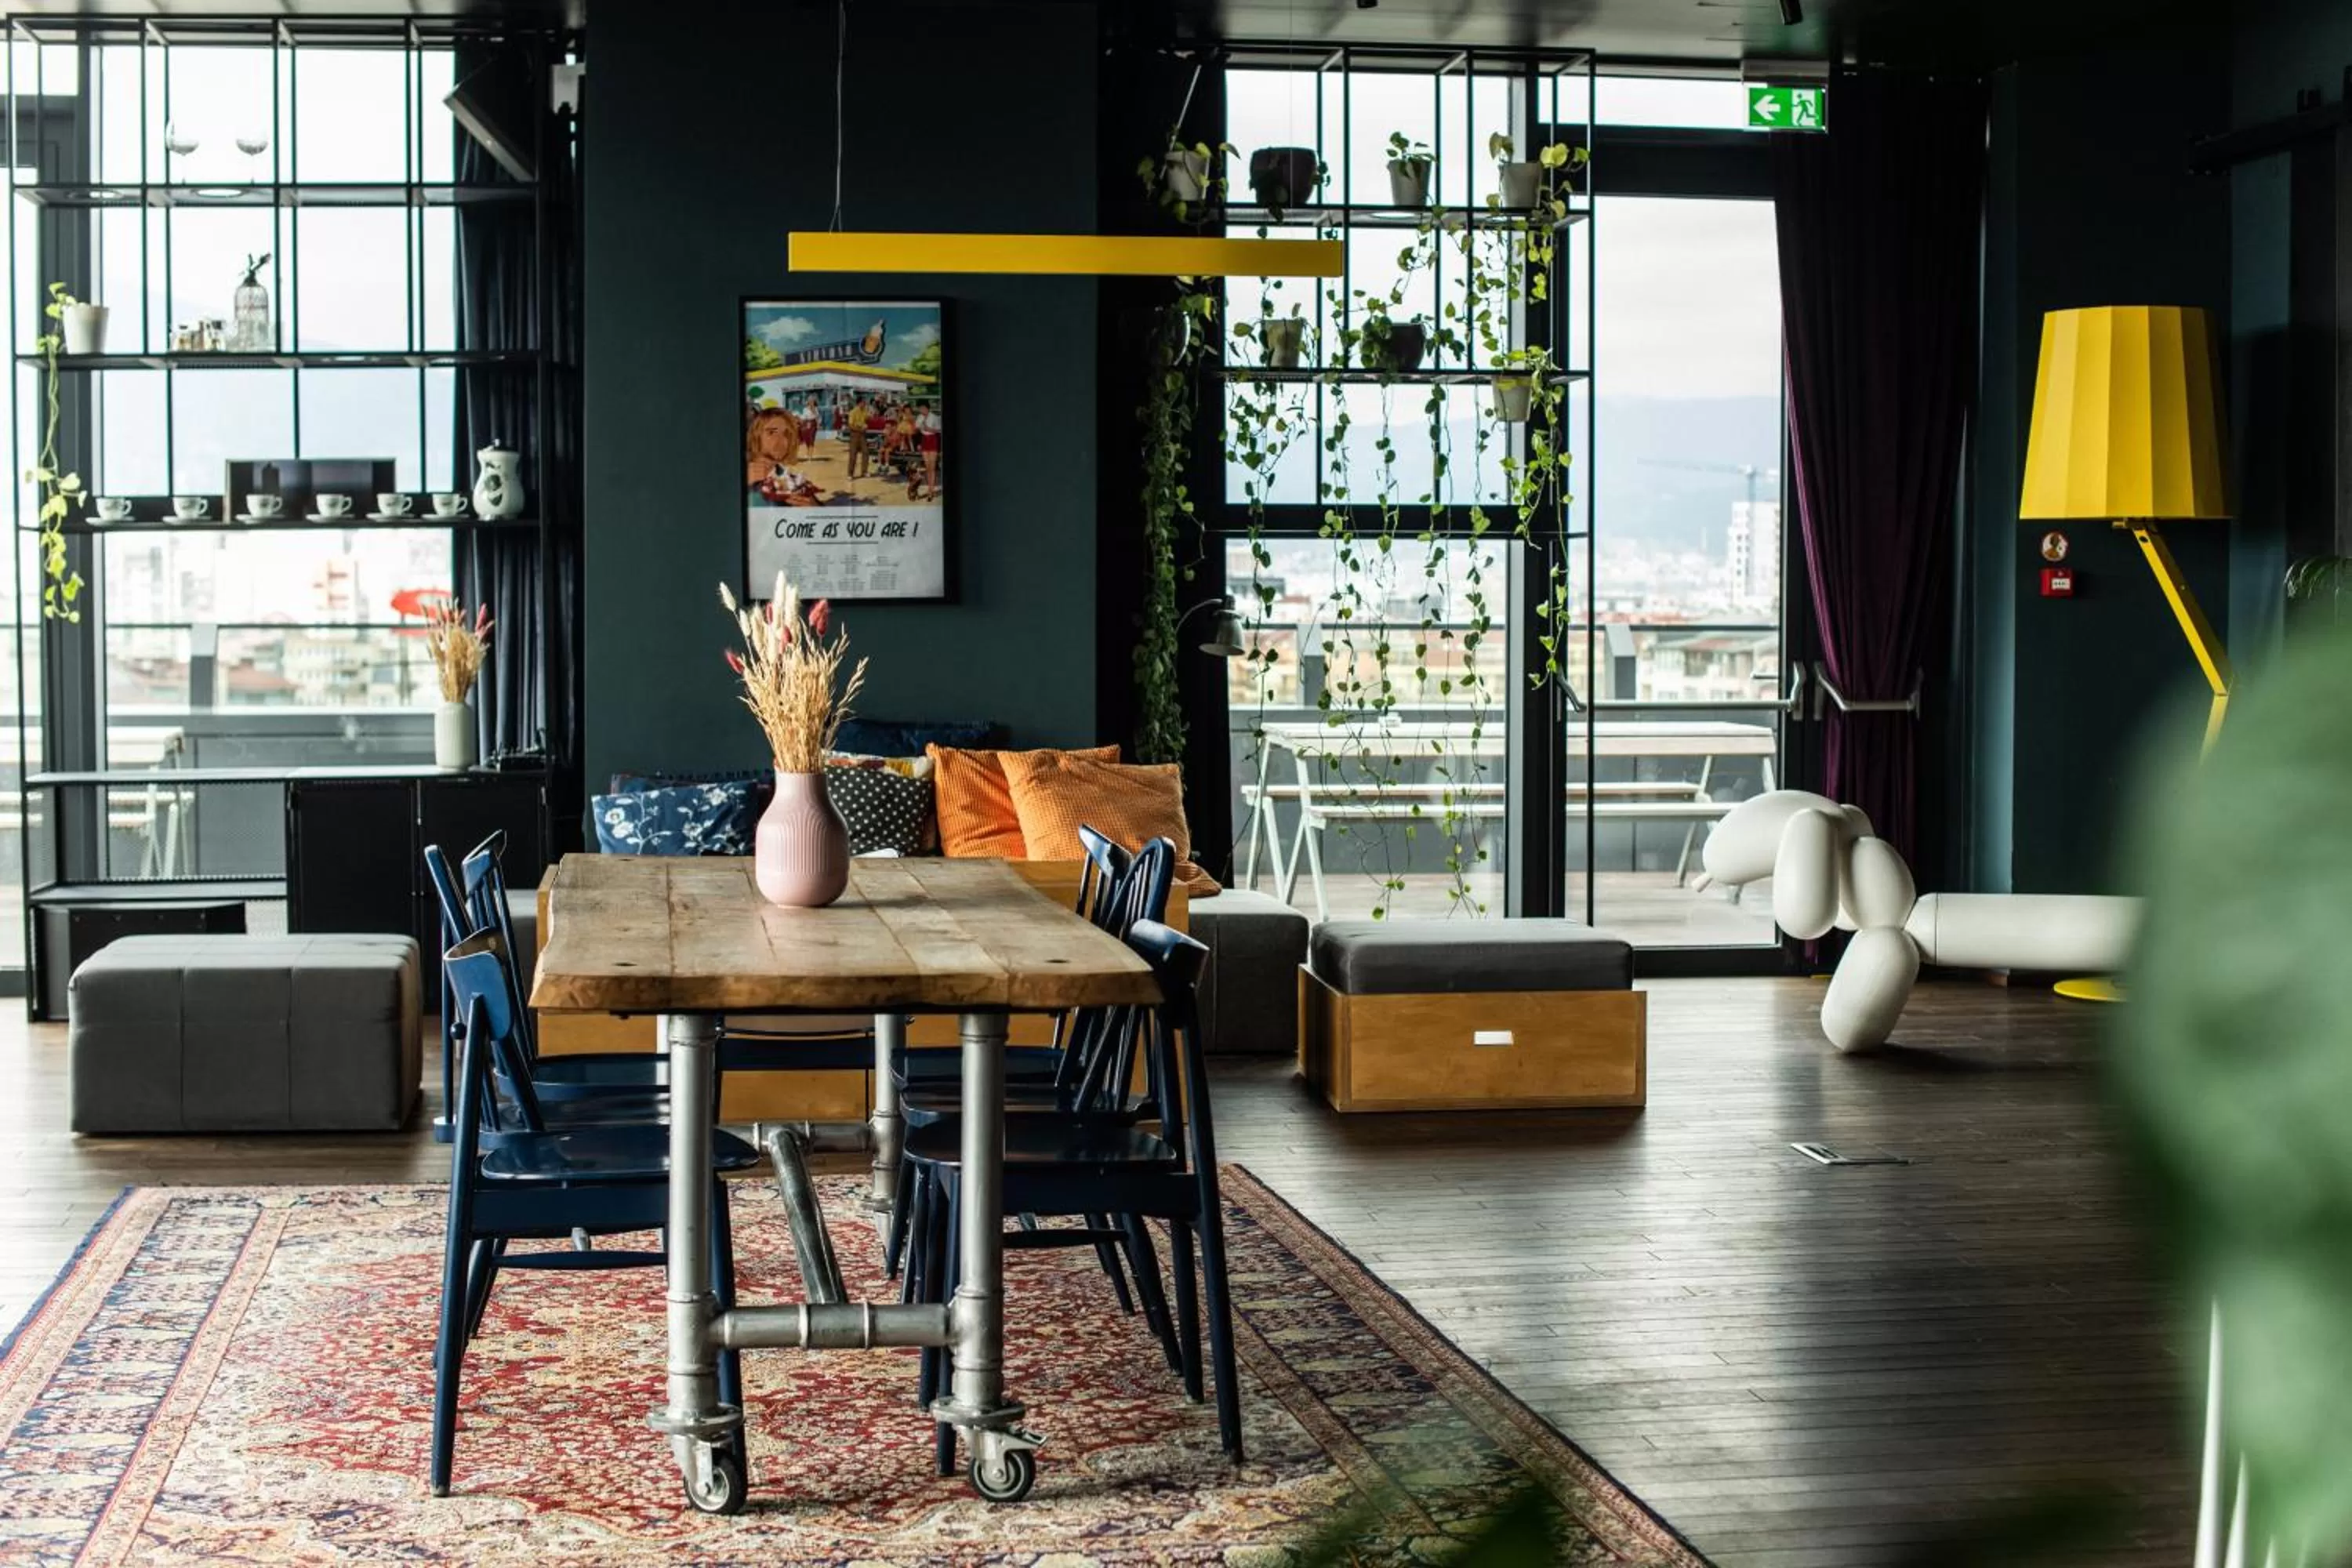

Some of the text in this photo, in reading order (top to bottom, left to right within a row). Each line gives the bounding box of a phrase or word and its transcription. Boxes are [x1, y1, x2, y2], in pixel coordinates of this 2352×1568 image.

[775, 518, 816, 538] COME
[822, 522, 840, 538] AS
[847, 521, 876, 538] YOU
[880, 521, 908, 538] ARE
